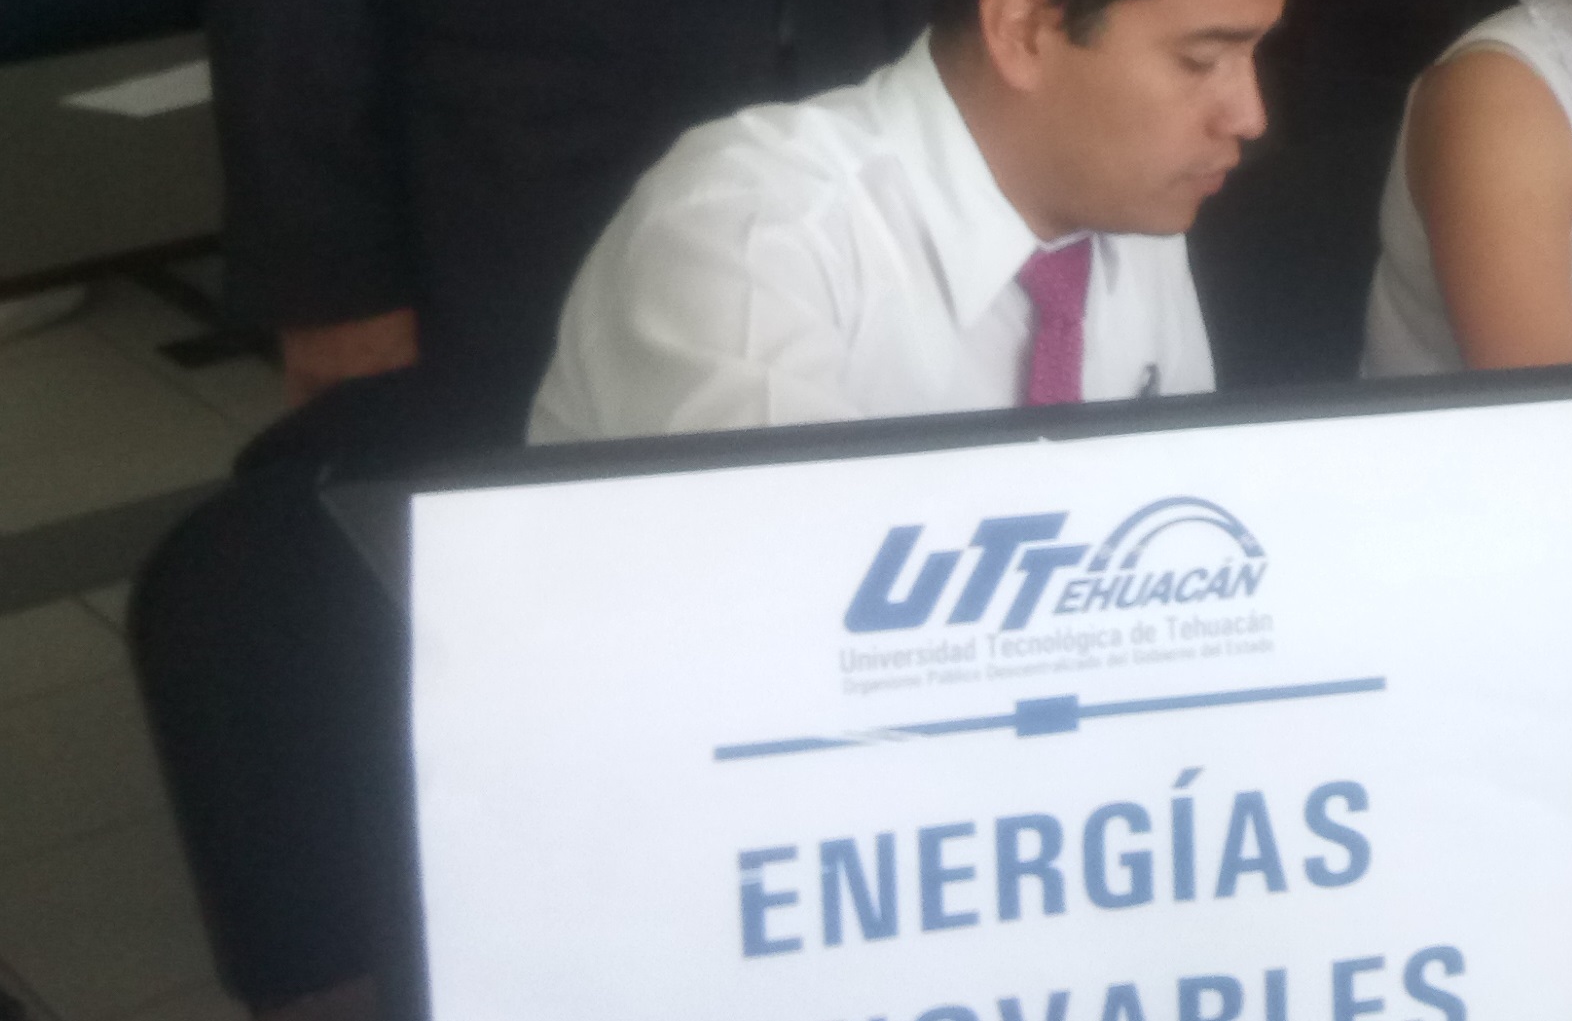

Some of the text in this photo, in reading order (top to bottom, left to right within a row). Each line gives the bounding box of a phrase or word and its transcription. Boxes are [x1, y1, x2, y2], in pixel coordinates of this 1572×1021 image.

[839, 608, 1274, 674] Universidad Tecnológica de Tehuacán
[842, 672, 922, 696] Organismo
[986, 654, 1101, 681] Descentralizado
[1107, 650, 1127, 668] del
[1132, 646, 1196, 666] Gobierno
[1200, 641, 1222, 659] del
[1225, 636, 1274, 656] Estado
[738, 767, 1372, 960] ENERGÍAS
